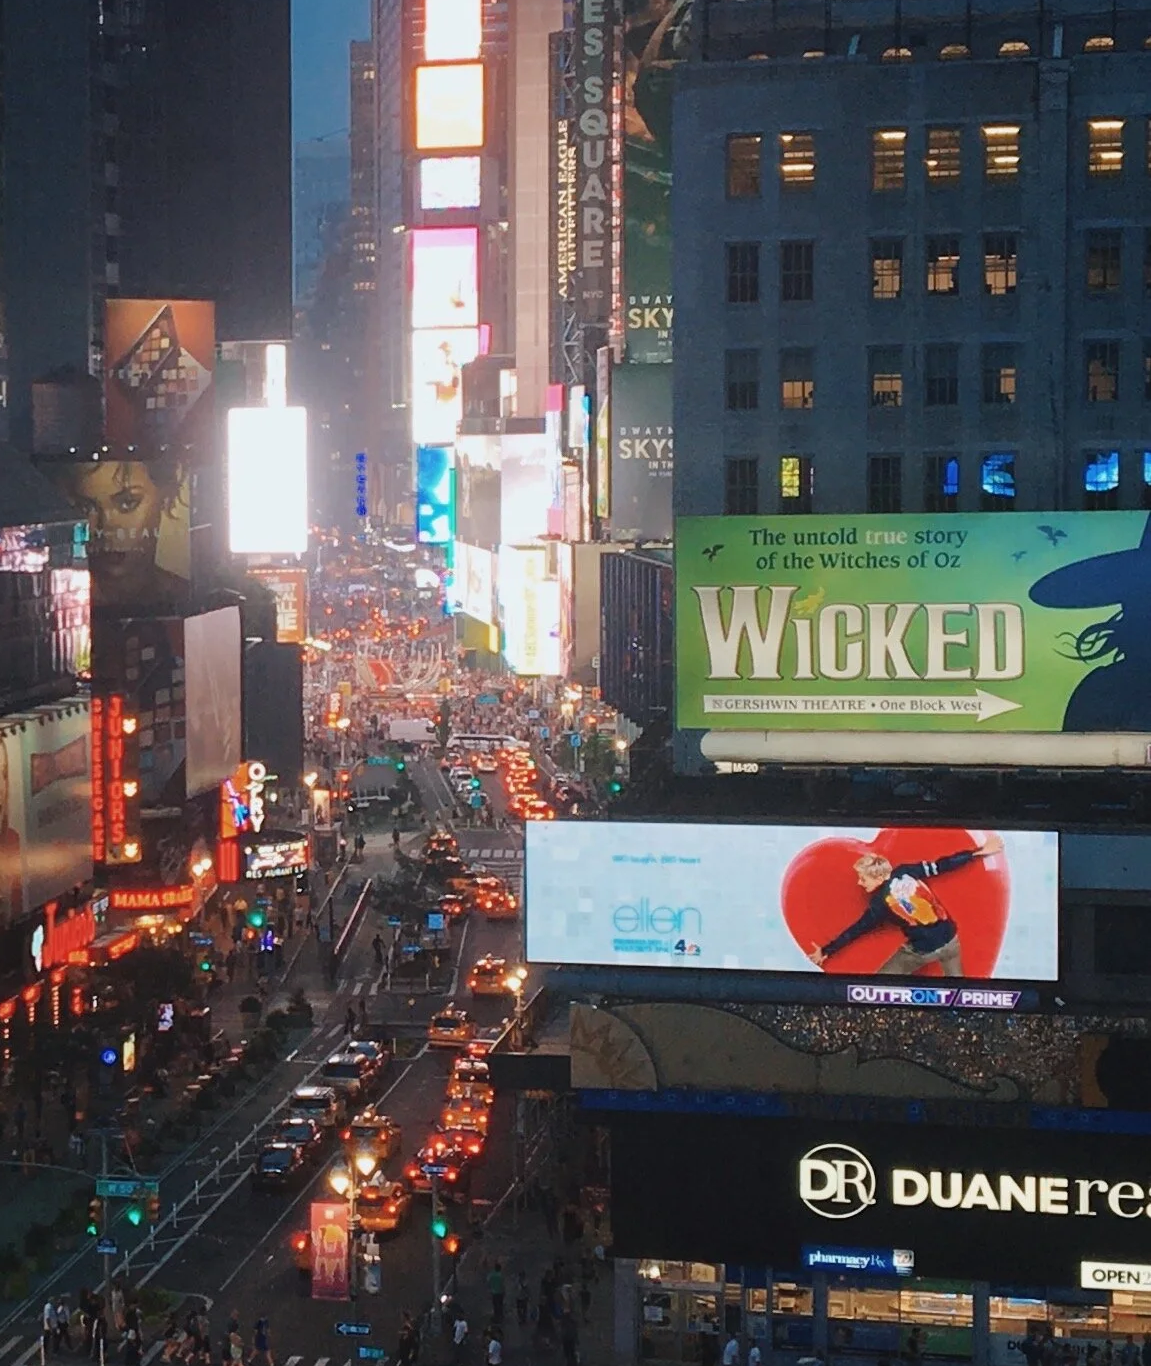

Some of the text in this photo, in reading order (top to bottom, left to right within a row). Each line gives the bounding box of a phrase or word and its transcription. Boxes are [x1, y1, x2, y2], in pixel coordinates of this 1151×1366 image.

[579, 76, 609, 268] SQUARE
[557, 120, 568, 299] AMERICAN EAGLE
[750, 527, 968, 549] The untold true story
[756, 550, 961, 570] of the Witches of Oz
[725, 698, 983, 711] GERSHWIN THEATRE One Block West
[113, 892, 160, 908] MAMA
[613, 896, 702, 934] ellen
[674, 939, 686, 953] 4
[851, 988, 1015, 1006] OUTFRONT PRIME
[892, 1168, 1069, 1215] DUANE
[1074, 1178, 1151, 1219] re
[809, 1250, 870, 1269] pharmacy
[1092, 1267, 1141, 1285] OPEN
